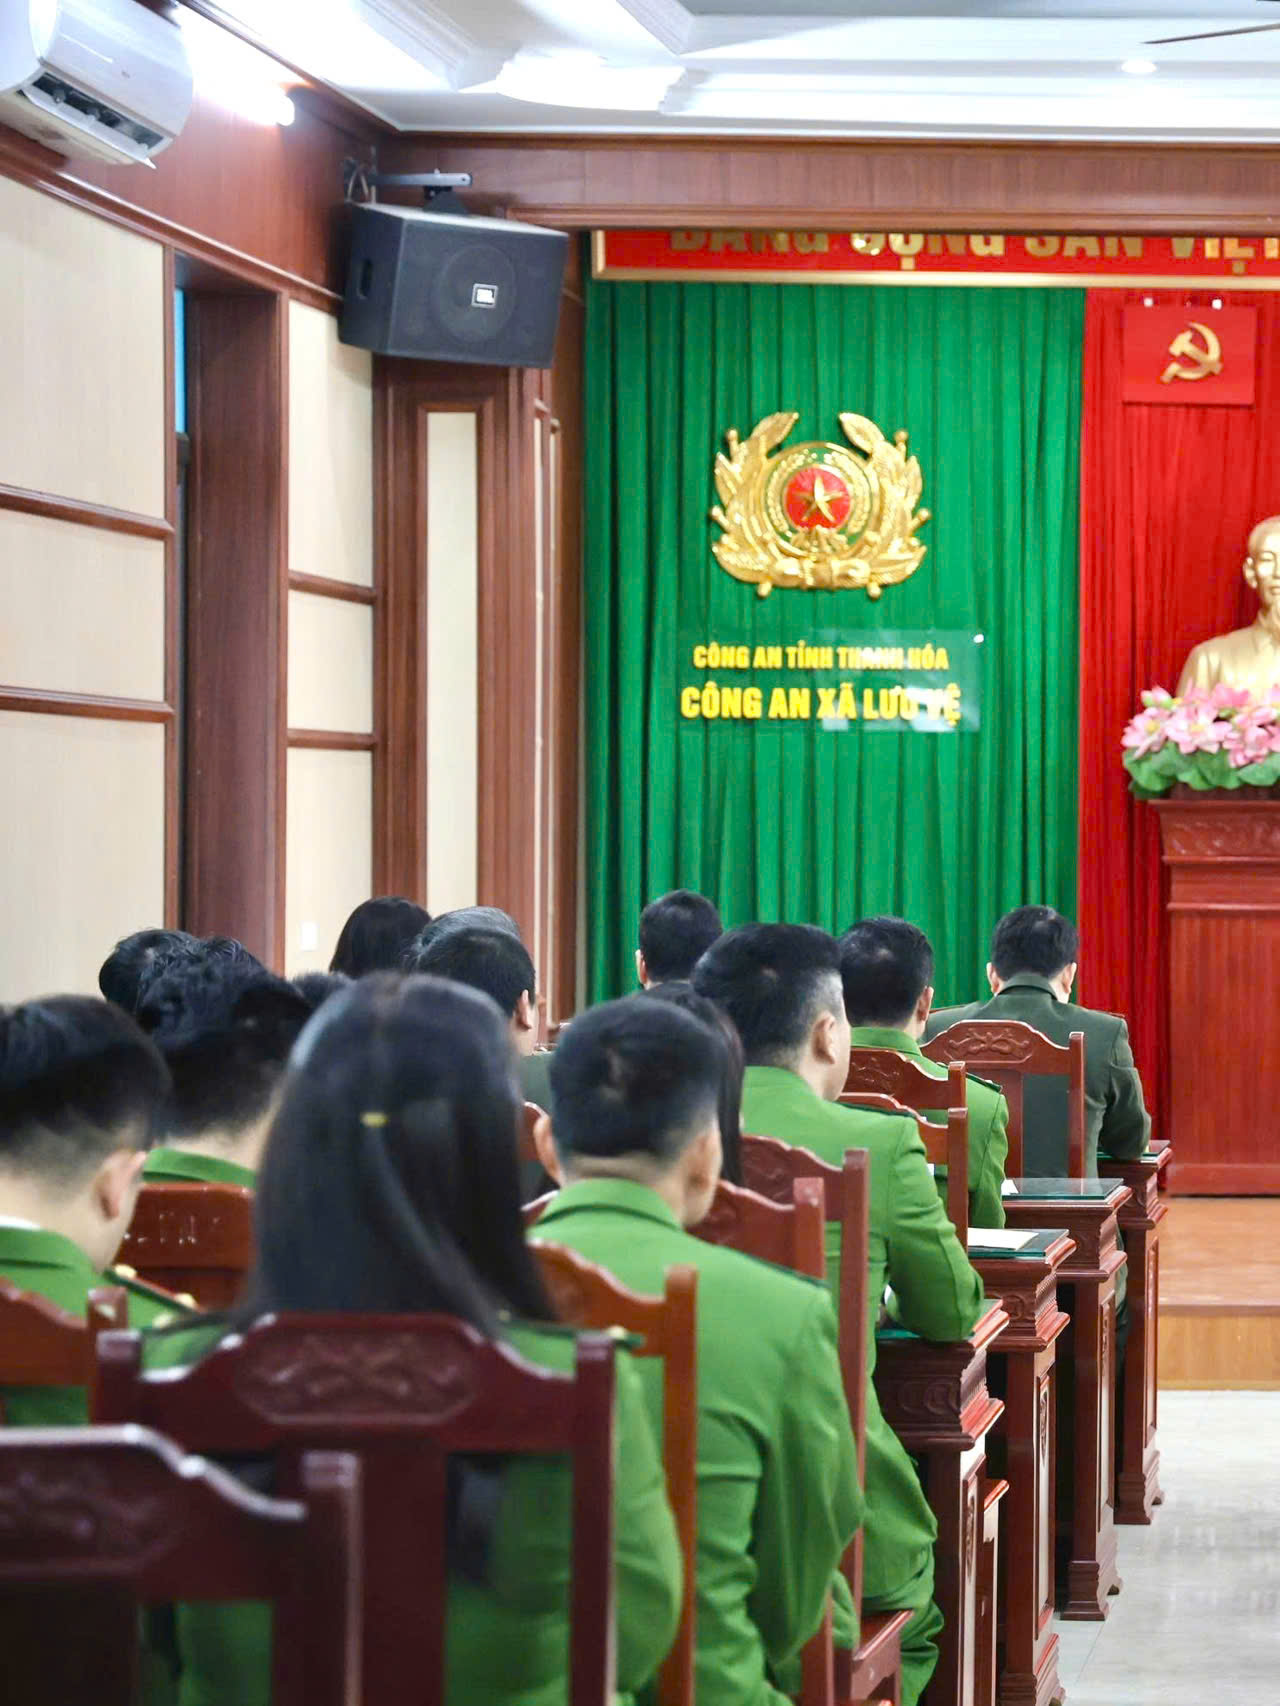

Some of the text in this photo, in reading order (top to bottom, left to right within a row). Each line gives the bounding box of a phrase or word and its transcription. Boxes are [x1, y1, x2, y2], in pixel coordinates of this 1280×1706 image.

[693, 641, 749, 669] CÔNG
[753, 646, 782, 669] AN
[838, 646, 904, 670] THANH
[907, 643, 949, 670] HÓA
[681, 681, 762, 718] CÔNG
[768, 687, 812, 719] AN
[817, 682, 857, 719] XÃ
